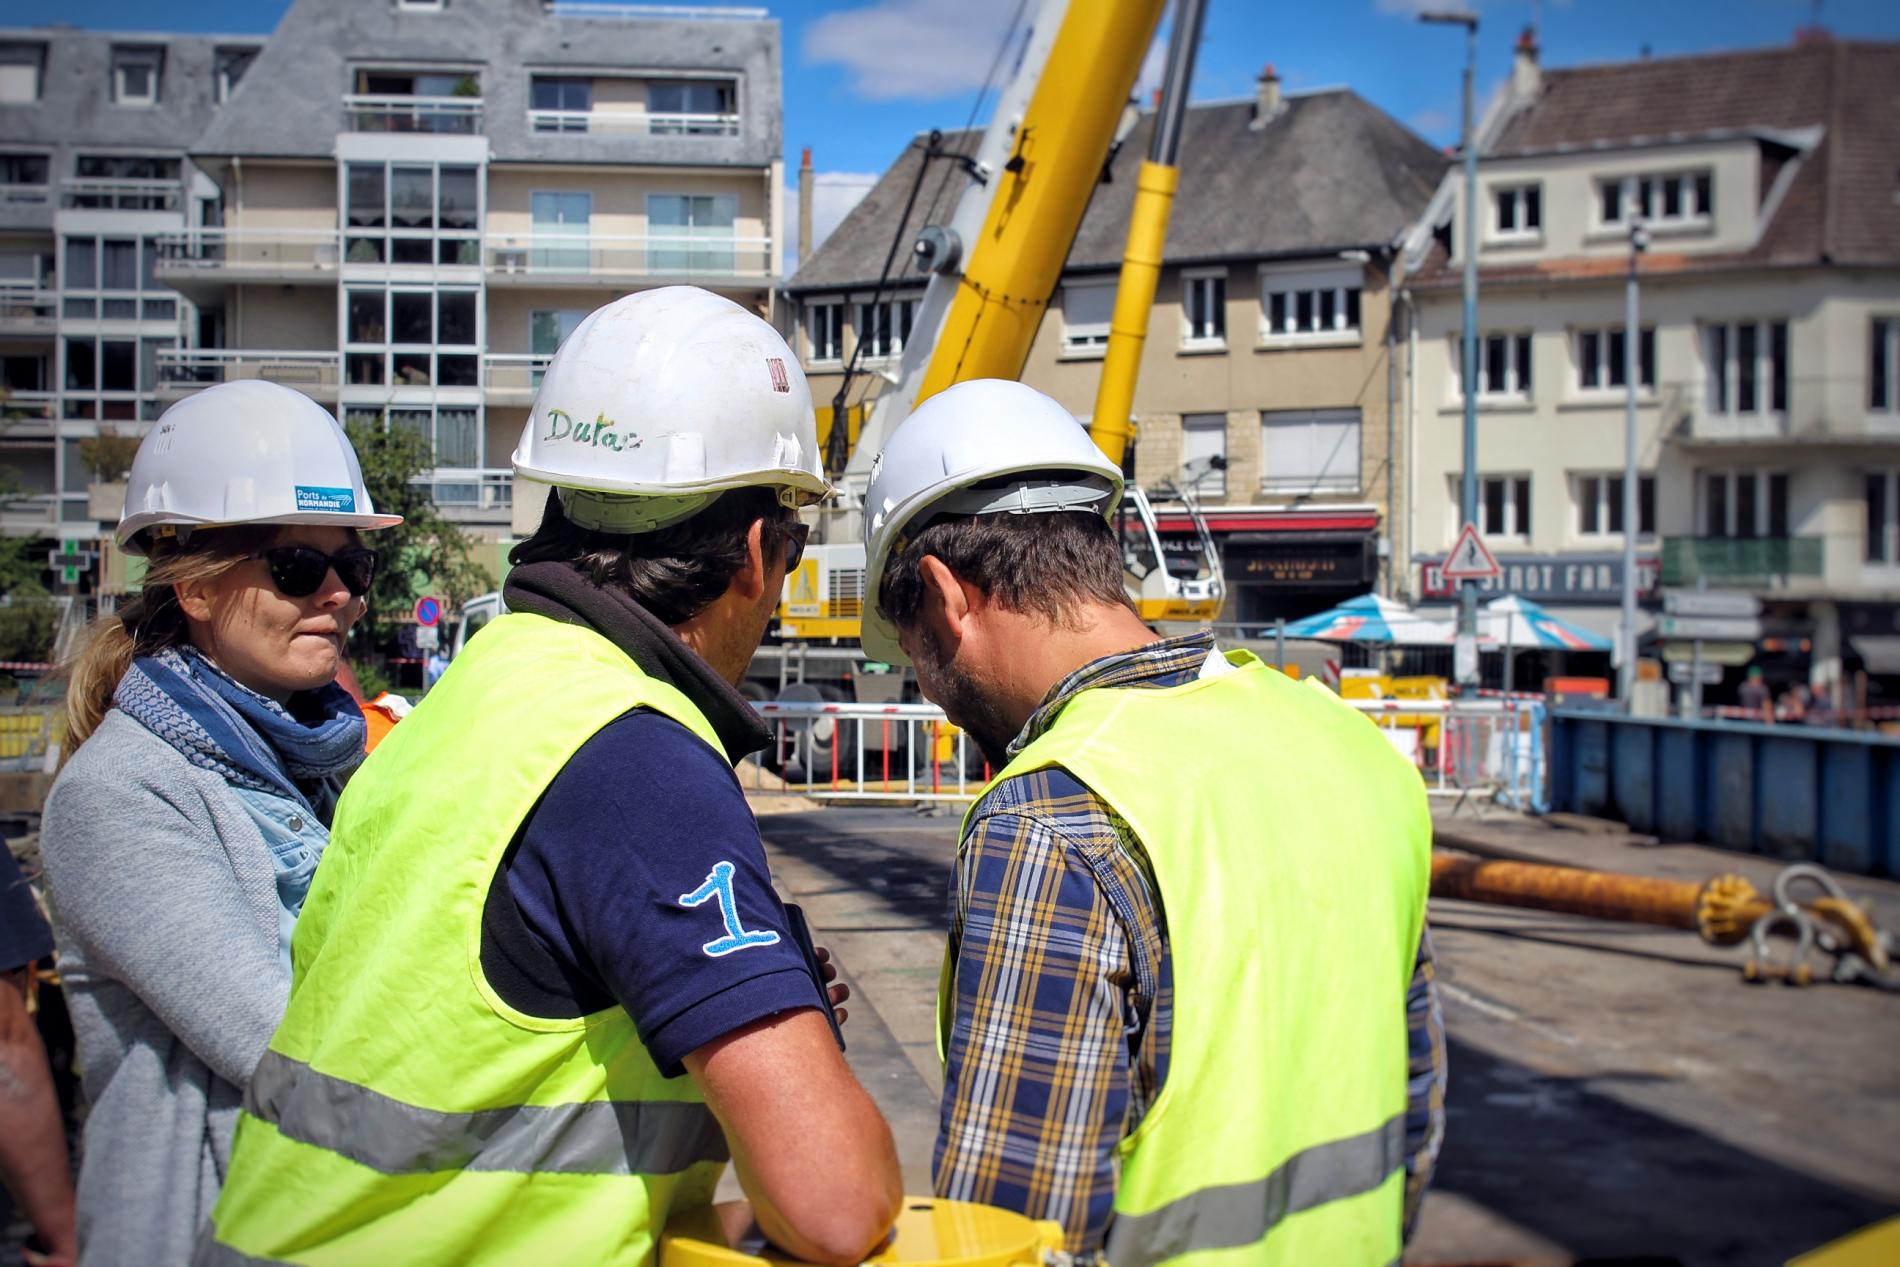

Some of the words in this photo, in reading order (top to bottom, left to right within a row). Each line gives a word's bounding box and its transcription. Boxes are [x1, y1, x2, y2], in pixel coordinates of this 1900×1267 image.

[297, 489, 320, 500] Ports
[298, 499, 341, 509] NORMANDIE
[678, 860, 781, 958] 1
